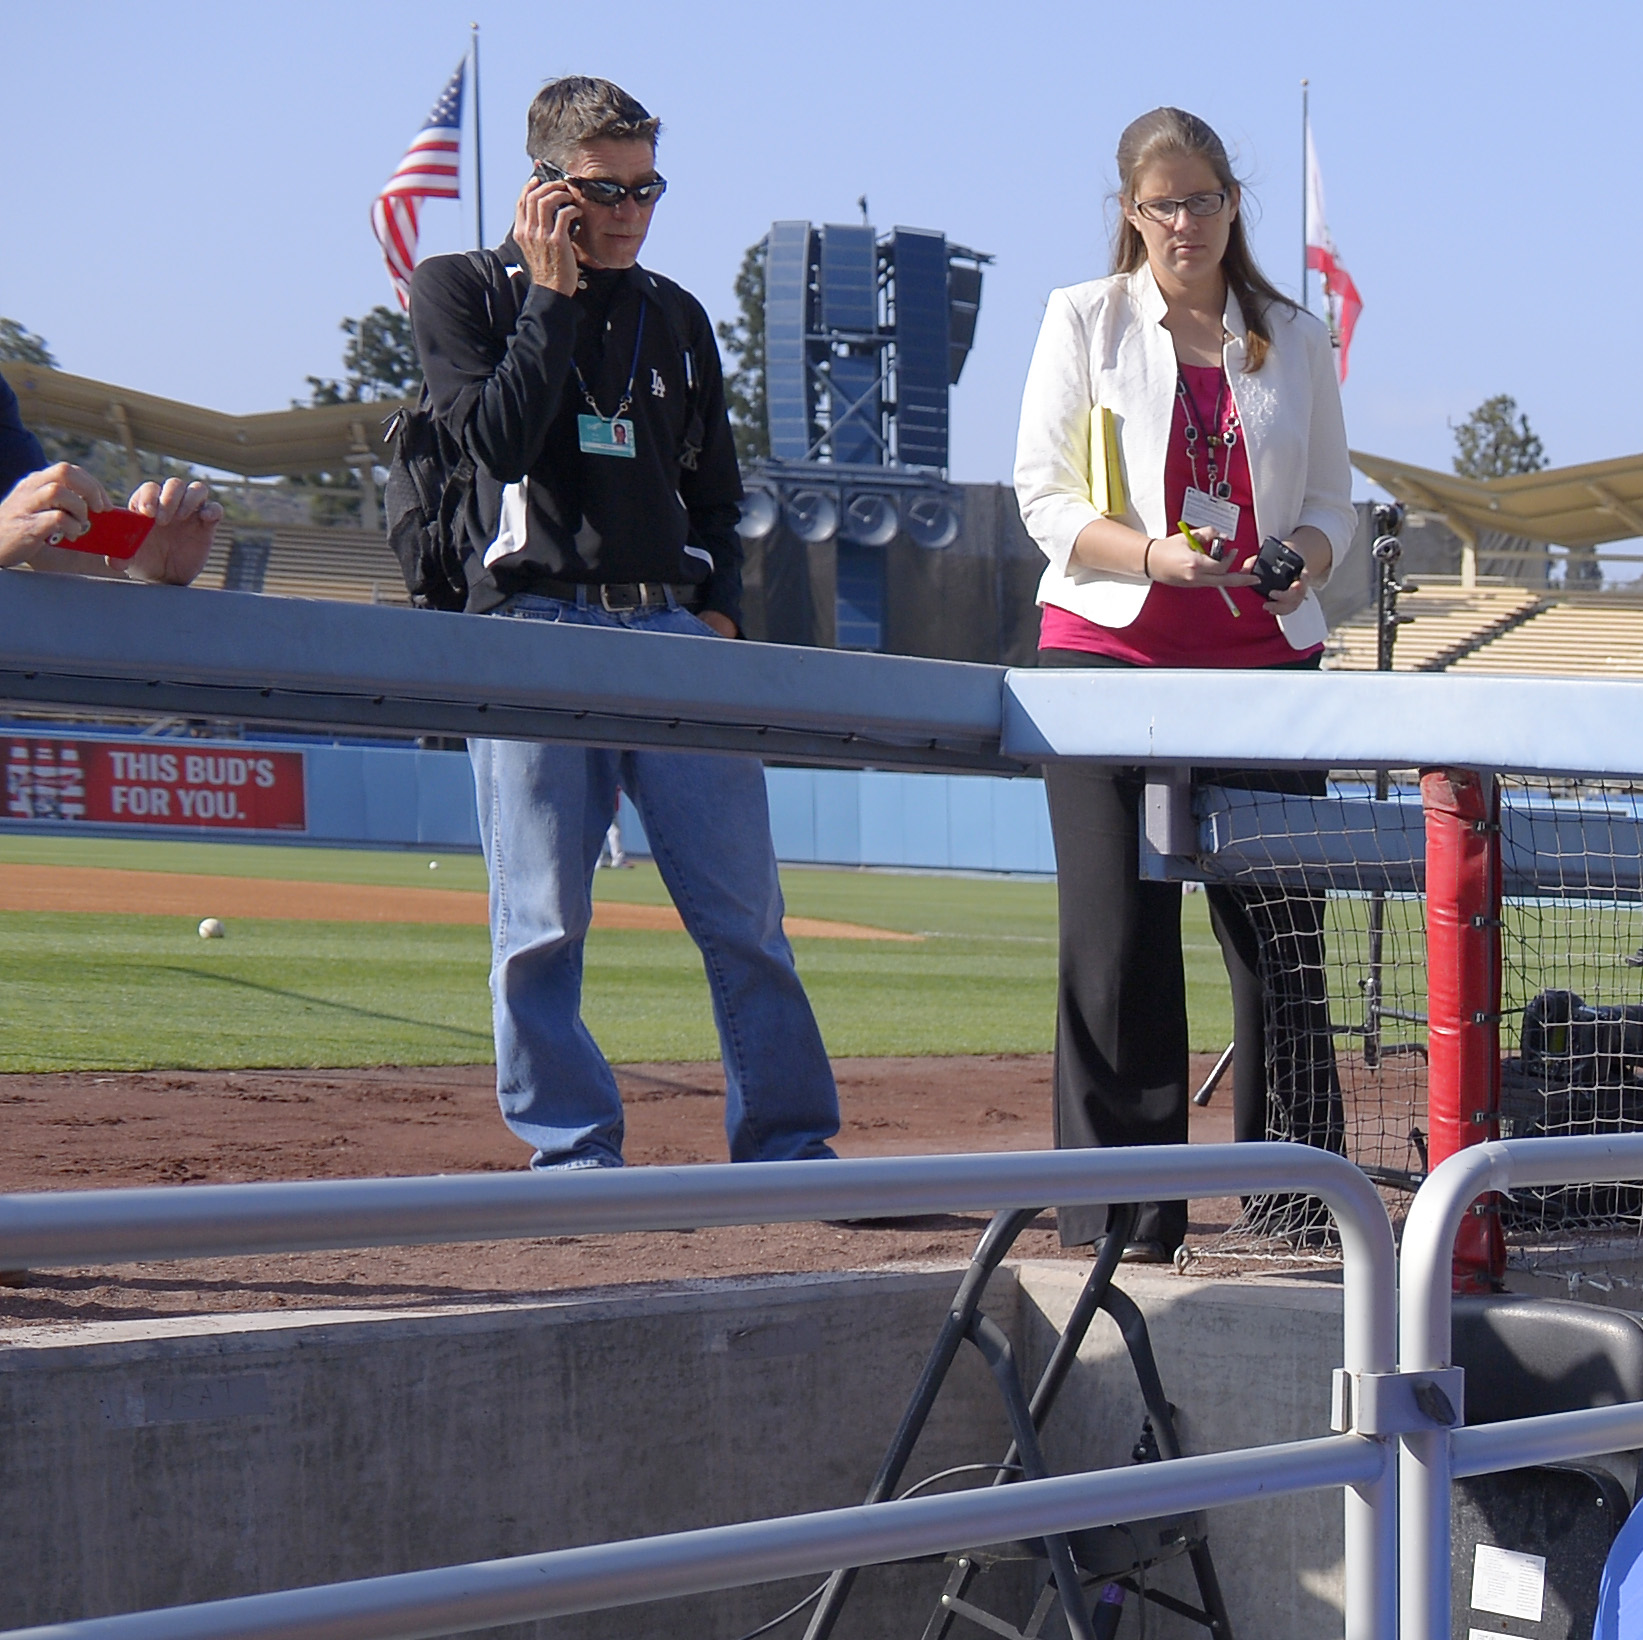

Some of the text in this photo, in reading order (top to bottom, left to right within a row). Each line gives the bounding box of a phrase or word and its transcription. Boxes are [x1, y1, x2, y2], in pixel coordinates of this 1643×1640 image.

[650, 367, 666, 398] LA
[108, 751, 277, 789] THIS BUD'S
[111, 785, 248, 820] FOR YOU.
